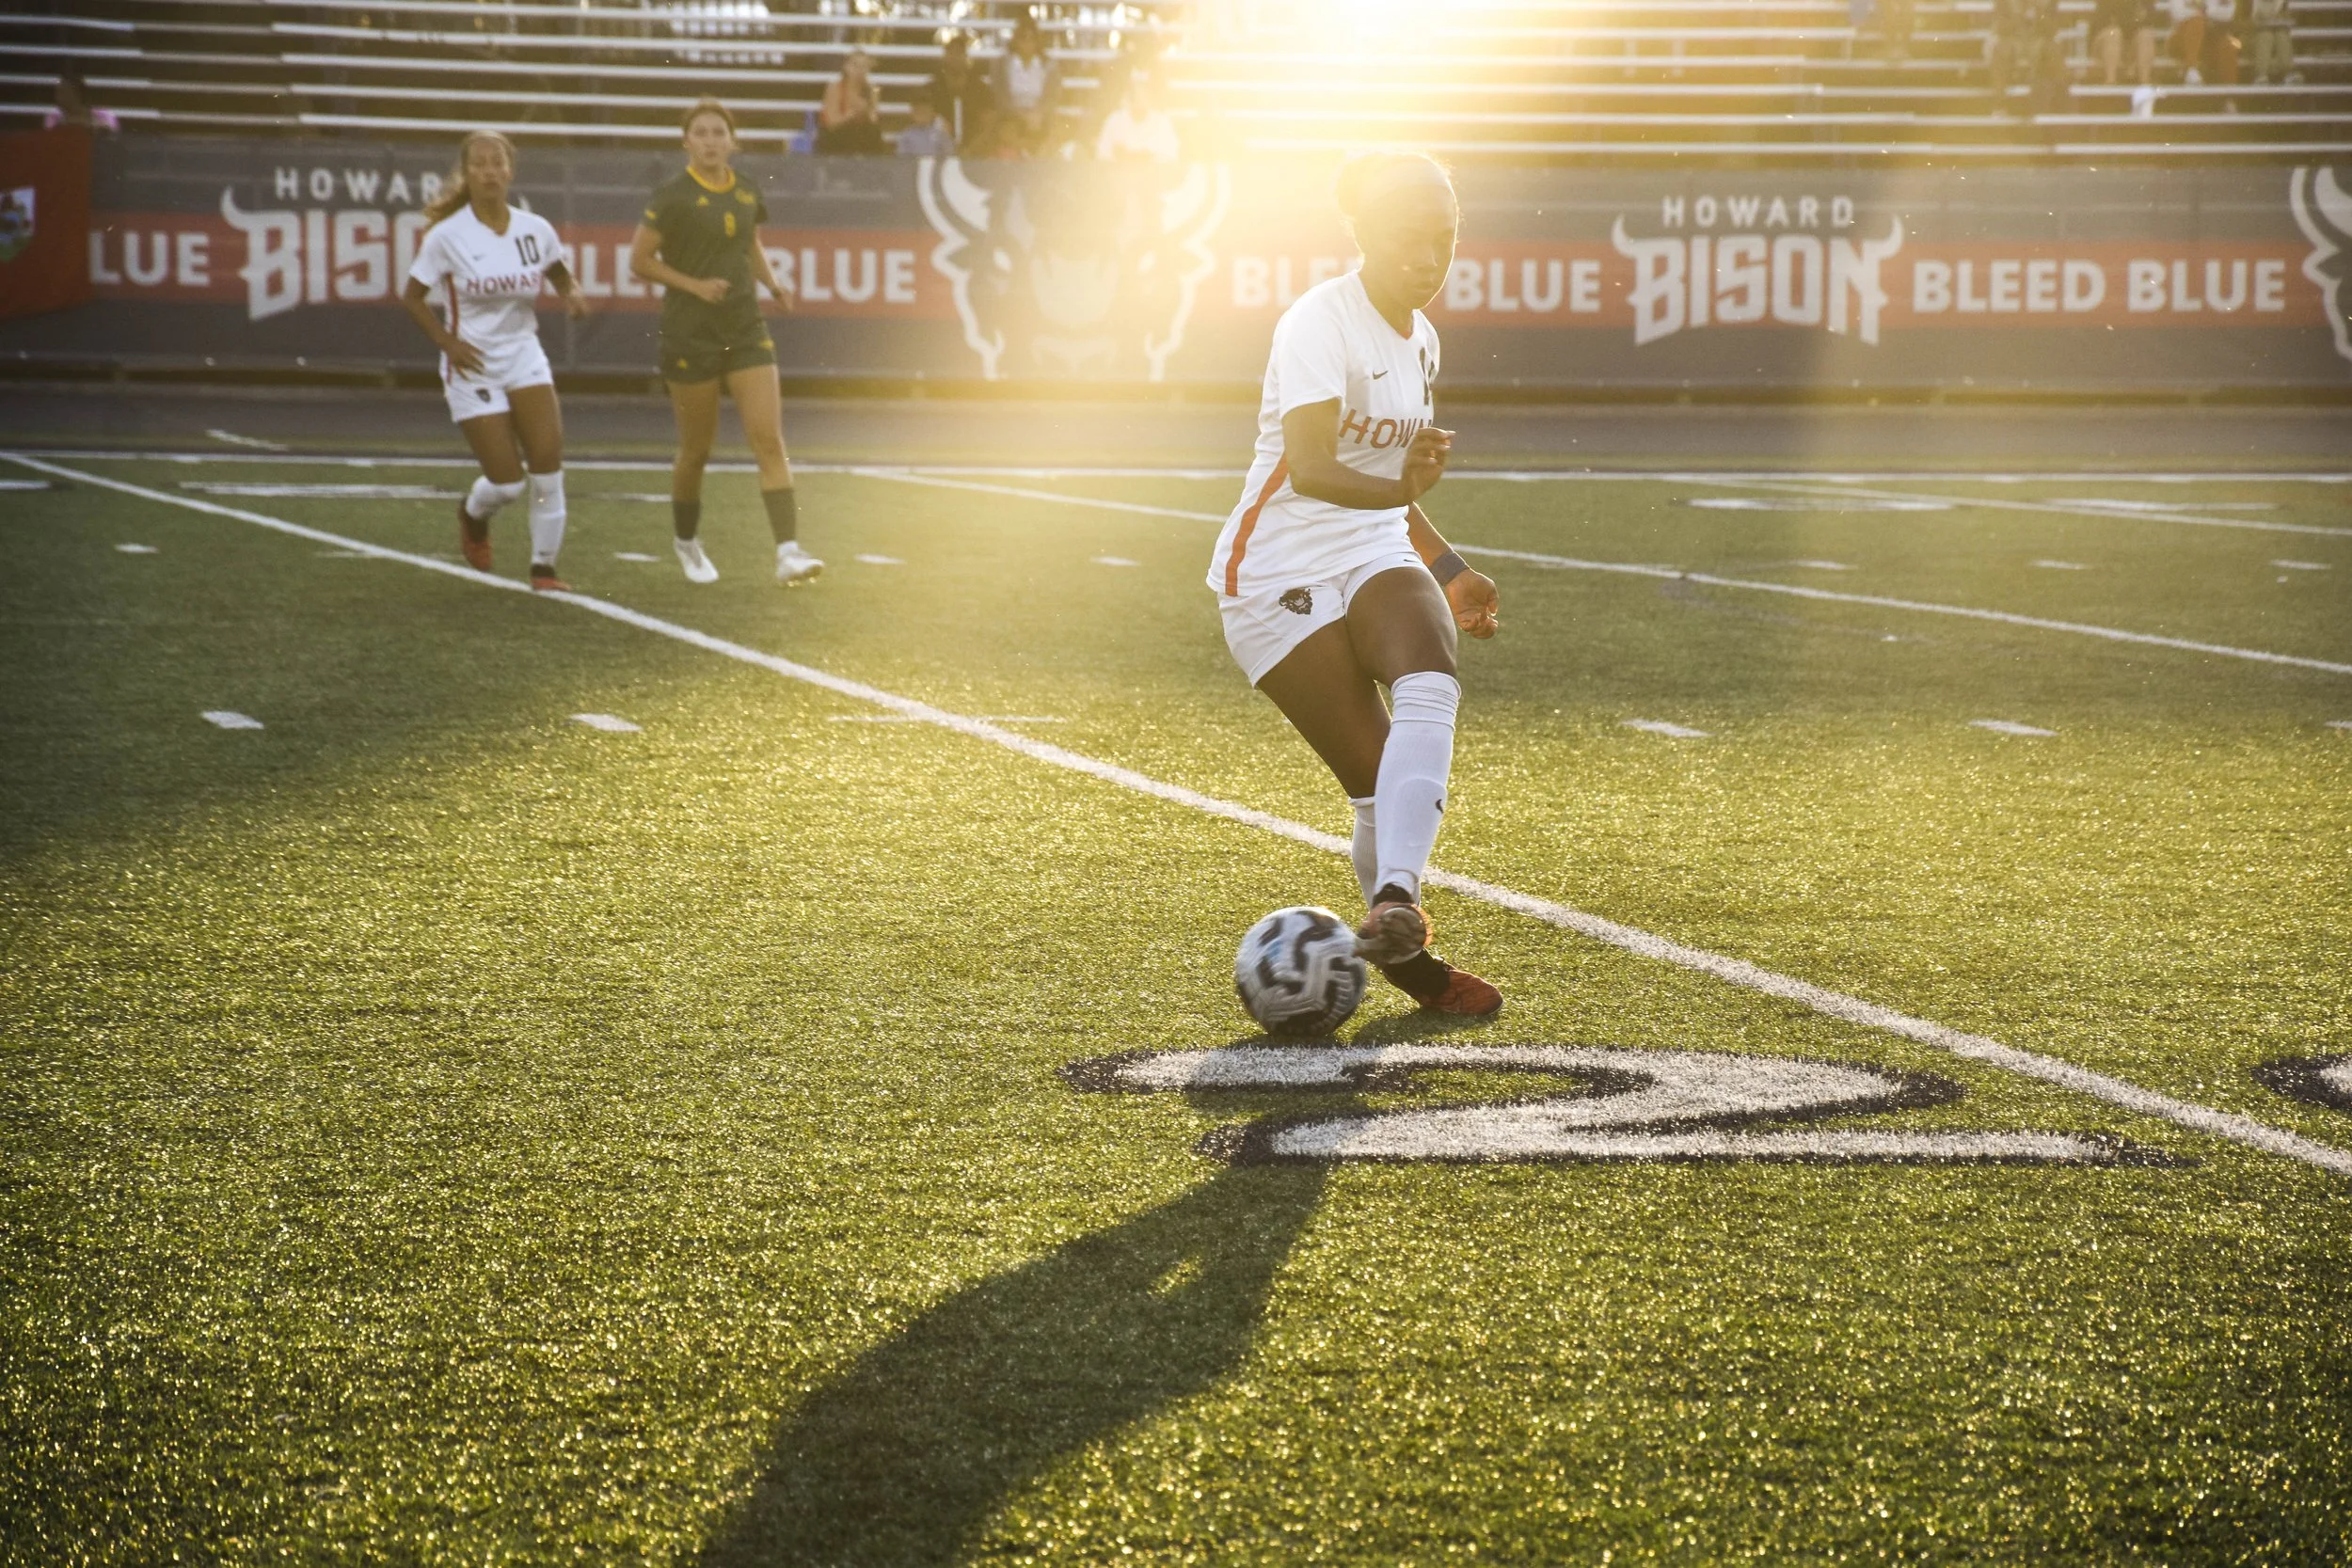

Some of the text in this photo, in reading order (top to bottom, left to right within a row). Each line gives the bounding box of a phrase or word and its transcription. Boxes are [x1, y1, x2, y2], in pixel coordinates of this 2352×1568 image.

[275, 166, 442, 205] HOWAR
[1661, 195, 1854, 229] HOWARD
[89, 231, 210, 286] LUE
[220, 186, 423, 323] BIS
[514, 233, 541, 267] 10
[1445, 258, 1601, 312] BLUE
[1612, 214, 1904, 347] BISON
[1913, 259, 2286, 313] BLEED BLUE
